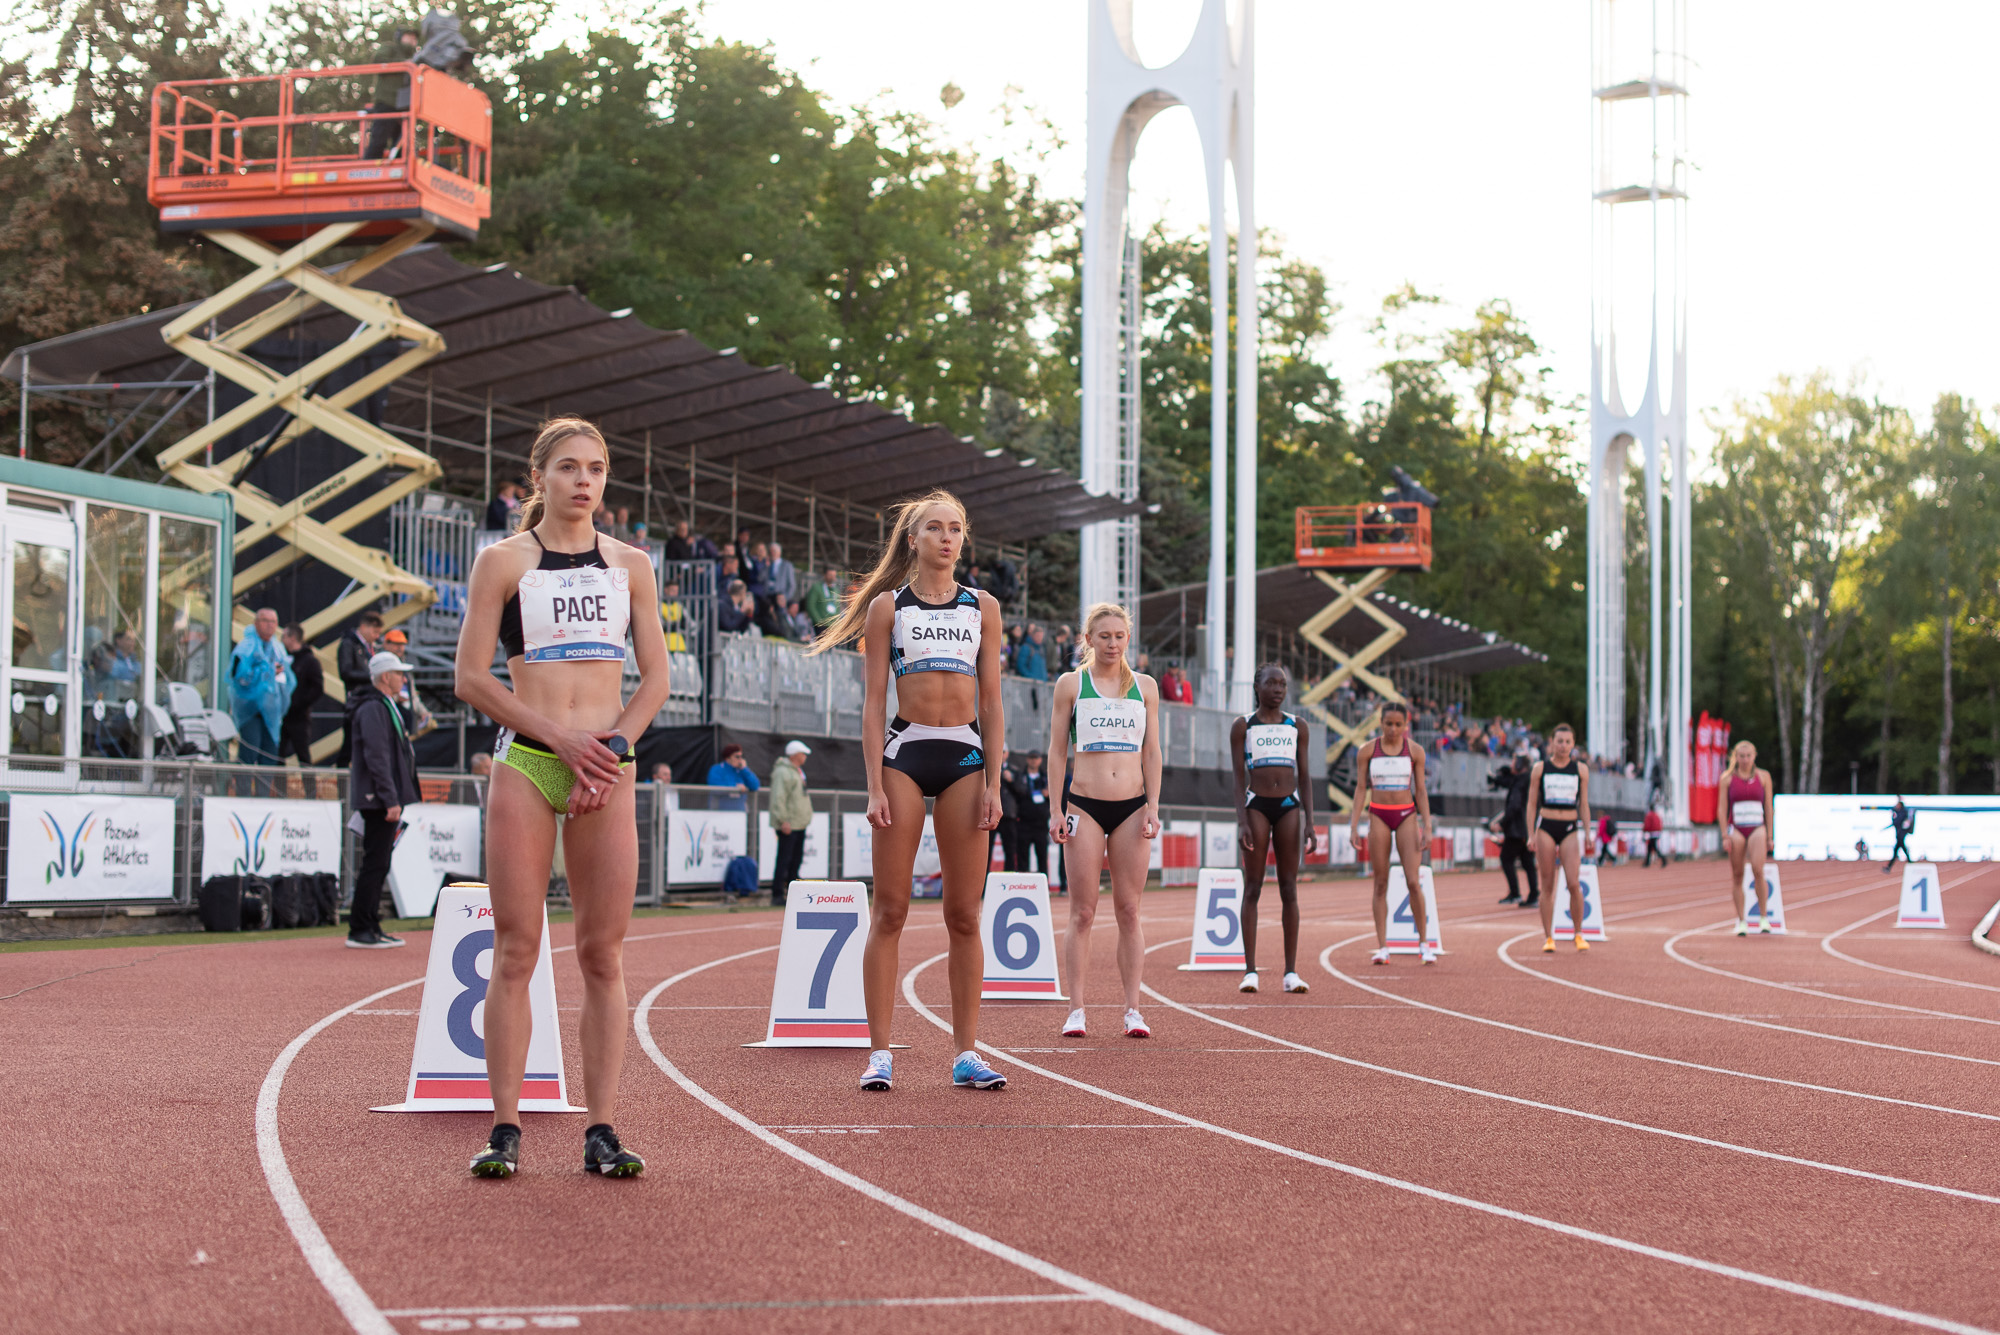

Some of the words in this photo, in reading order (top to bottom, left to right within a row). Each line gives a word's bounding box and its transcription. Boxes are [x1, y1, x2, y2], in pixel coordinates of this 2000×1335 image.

[302, 475, 347, 508] mateco
[552, 595, 608, 624] PACE
[911, 626, 973, 643] SARNA
[565, 647, 601, 657] POZNAŃ
[930, 660, 957, 670] POZNAŃ
[1090, 717, 1136, 728] CZAPLA
[1256, 737, 1293, 747] OBOYA
[959, 758, 984, 766] adidas
[104, 818, 140, 840] Poznań
[281, 818, 311, 840] Poznań
[1066, 815, 1075, 834] 6
[103, 843, 149, 866] Athletics
[280, 843, 319, 863] Athletics
[1008, 883, 1038, 891] polanik
[1748, 879, 1774, 917] 2
[1911, 877, 1928, 913] 1
[816, 894, 855, 905] polanik
[1393, 884, 1429, 934] 4
[1565, 880, 1592, 921] 3
[1205, 888, 1240, 947] 5
[992, 896, 1041, 970] 6
[796, 911, 859, 1009] 7
